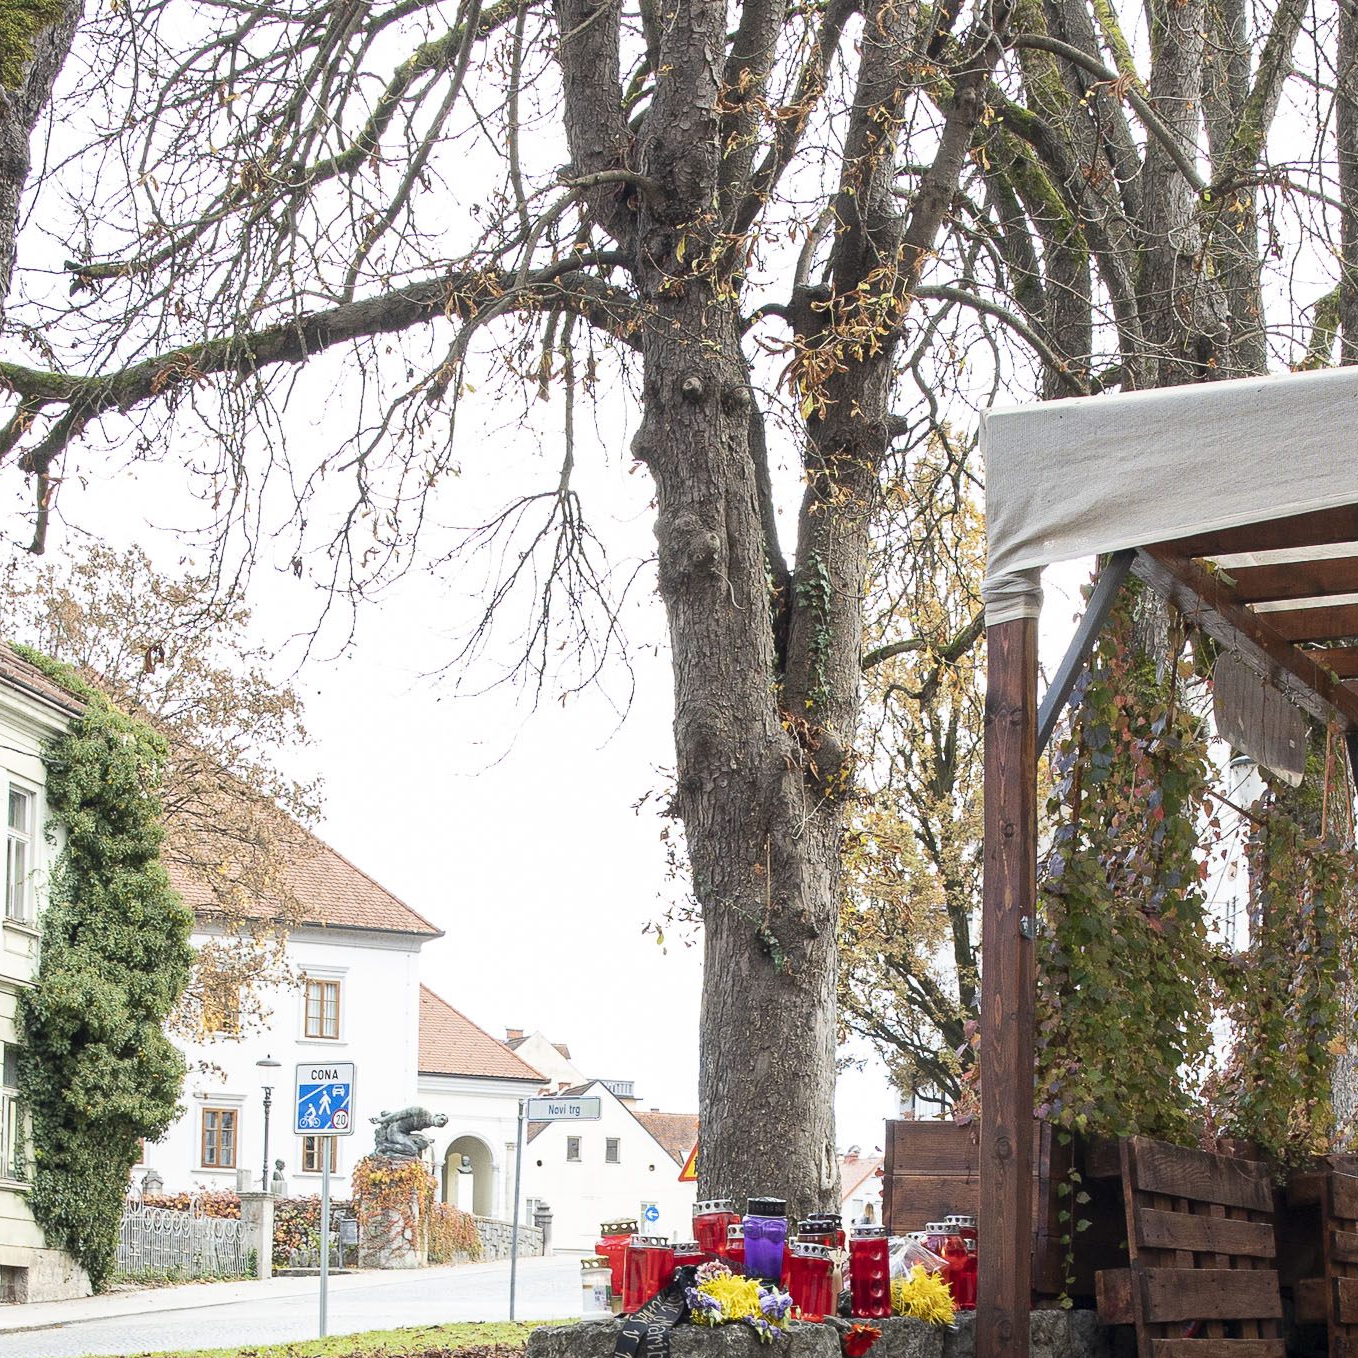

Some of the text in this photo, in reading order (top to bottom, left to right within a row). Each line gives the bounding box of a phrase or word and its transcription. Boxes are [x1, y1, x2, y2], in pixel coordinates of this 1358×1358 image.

[311, 1069, 339, 1081] CONA
[548, 1104, 581, 1116] Novi trg
[336, 1114, 347, 1126] 20
